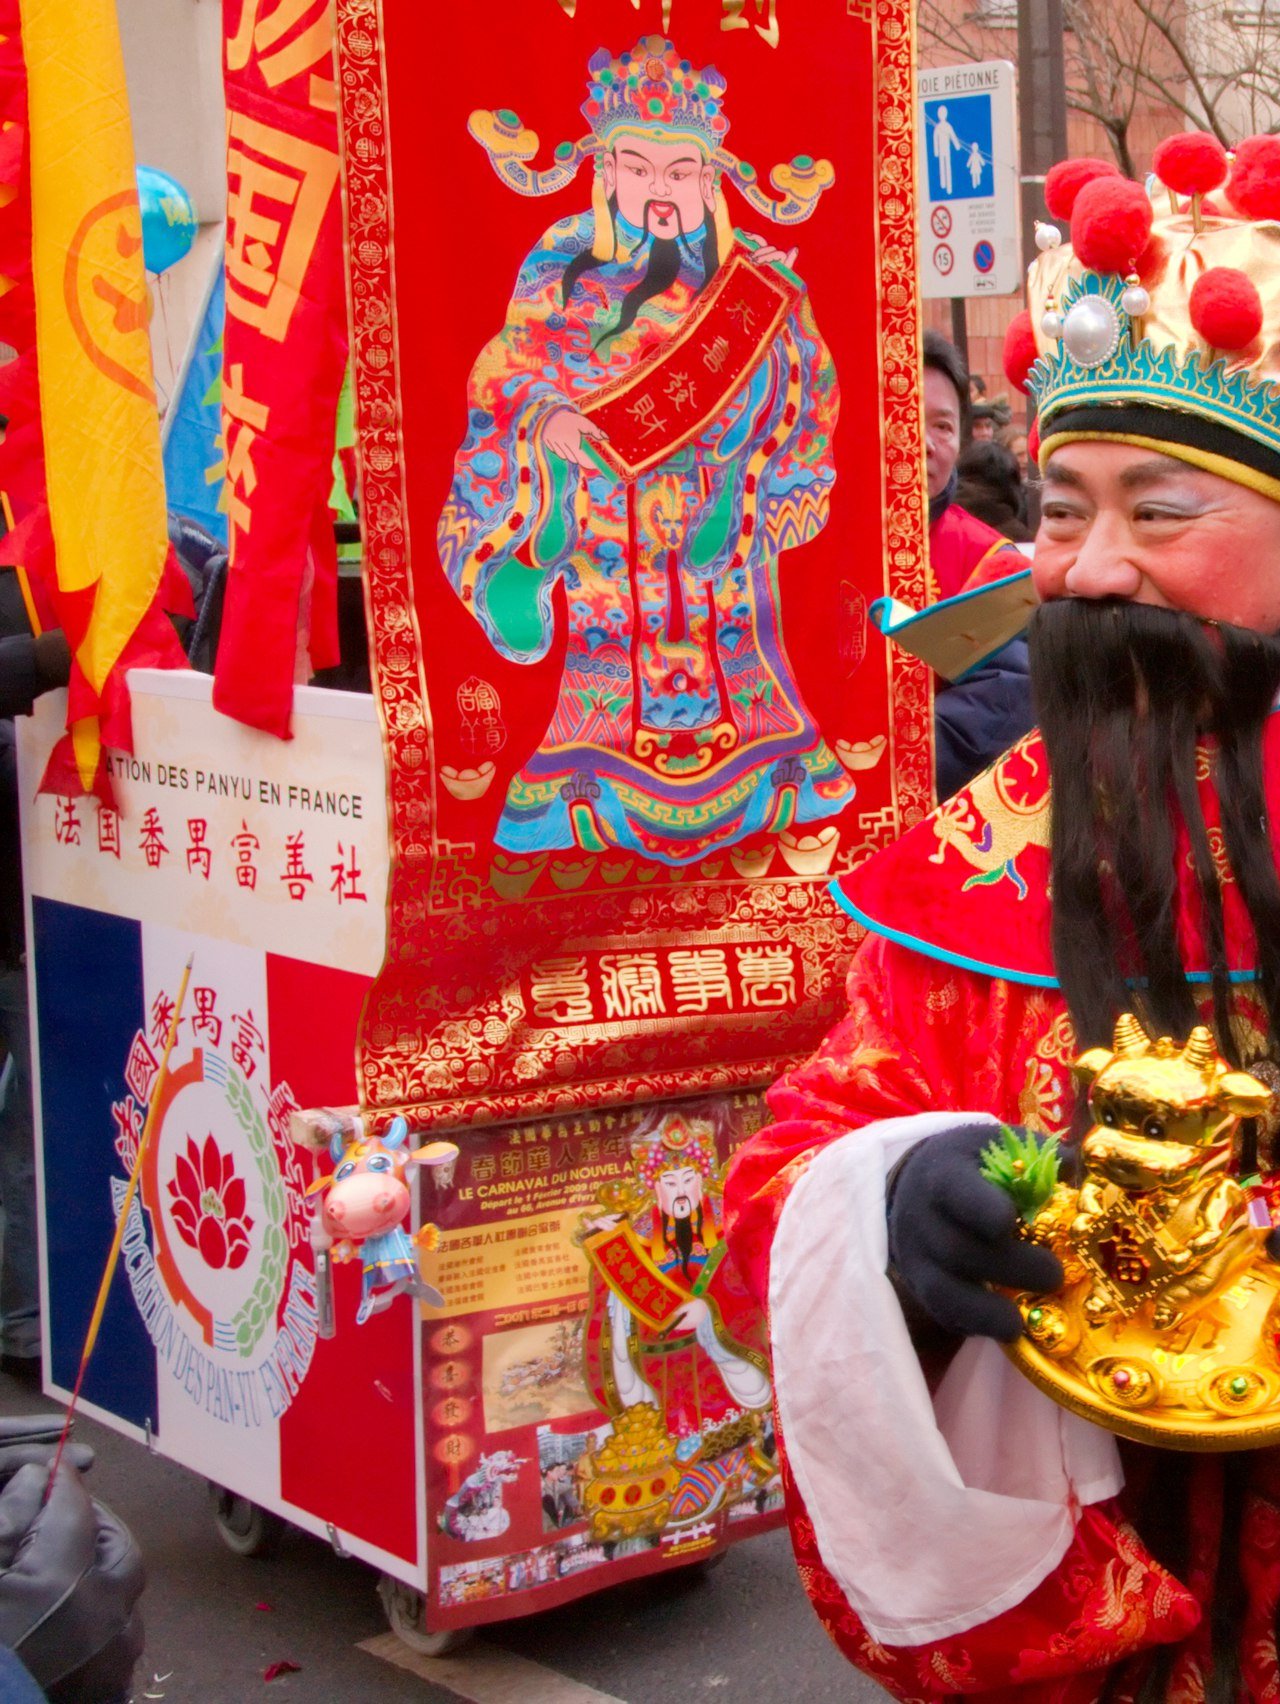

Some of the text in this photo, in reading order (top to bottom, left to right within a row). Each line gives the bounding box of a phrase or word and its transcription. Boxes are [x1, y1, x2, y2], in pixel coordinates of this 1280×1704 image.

[944, 69, 999, 89] PIÉTONNE
[938, 252, 949, 266] 15
[158, 764, 190, 789] DES
[196, 770, 251, 801] PANYU
[259, 781, 281, 805] EN
[288, 786, 363, 819] FRANCE
[459, 1187, 473, 1201] LE
[477, 1178, 549, 1199] CARNAVAL
[552, 1171, 568, 1185] DU
[570, 1162, 620, 1181] NOUVEL
[514, 1194, 524, 1206] le
[536, 1196, 566, 1210] Avenue
[1098, 1219, 1150, 1286] 福
[273, 1258, 319, 1397] FRANCE
[172, 1348, 204, 1404] DES
[259, 1351, 292, 1419] EN
